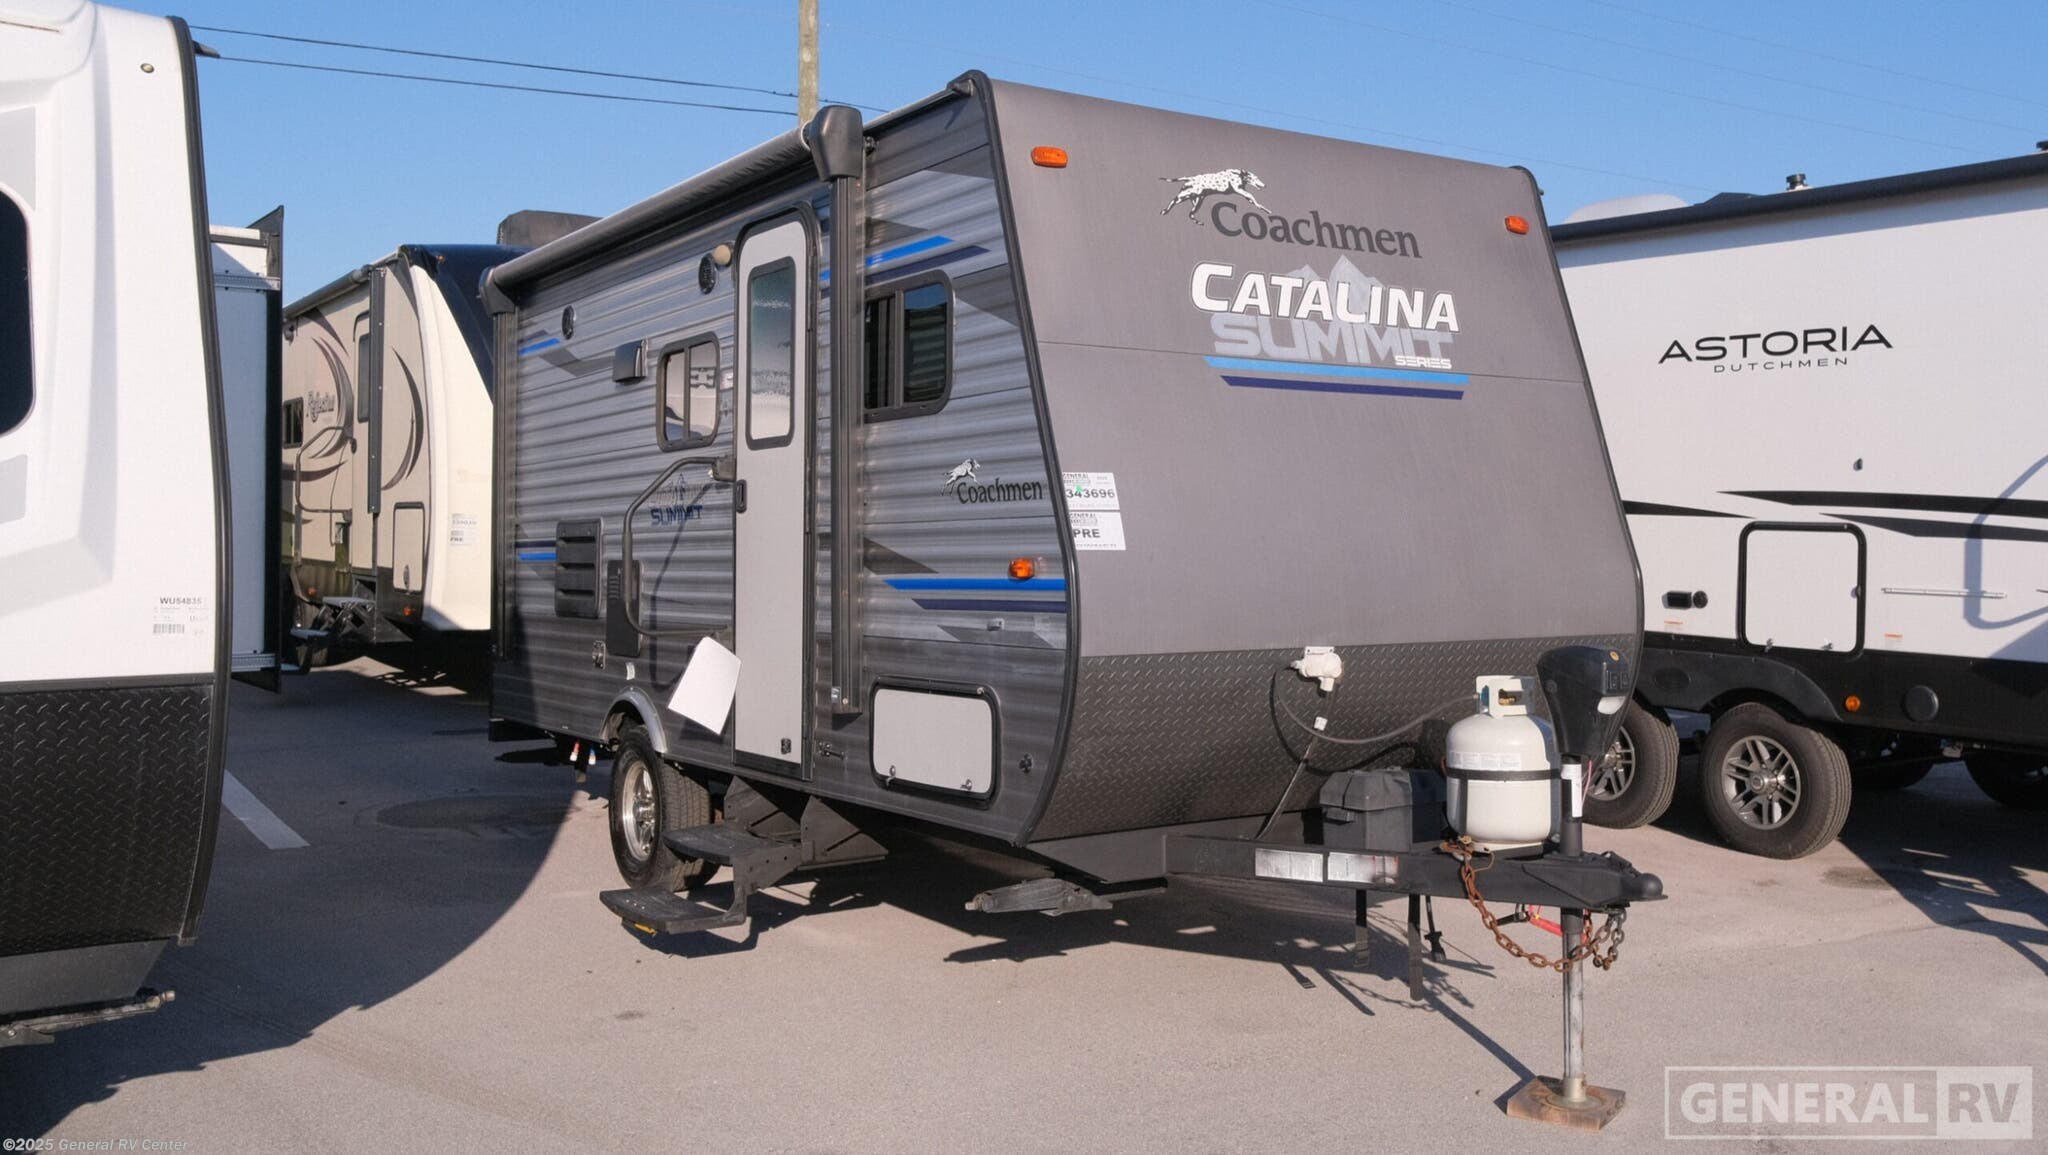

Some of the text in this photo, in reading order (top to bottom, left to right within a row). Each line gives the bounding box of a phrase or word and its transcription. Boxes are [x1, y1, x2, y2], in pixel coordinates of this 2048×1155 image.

[1210, 201, 1423, 259] Coachmen
[1191, 261, 1460, 333] CATALINA
[1210, 312, 1456, 365] SUMMIT
[1658, 324, 1893, 364] ASTORIA
[1394, 355, 1453, 370] SERIES
[1713, 357, 1848, 373] DUTCHMEN
[957, 477, 1043, 504] Coachmen
[1066, 488, 1116, 499] 343696
[649, 504, 703, 526] SUMMIT
[1073, 528, 1101, 539] PRE
